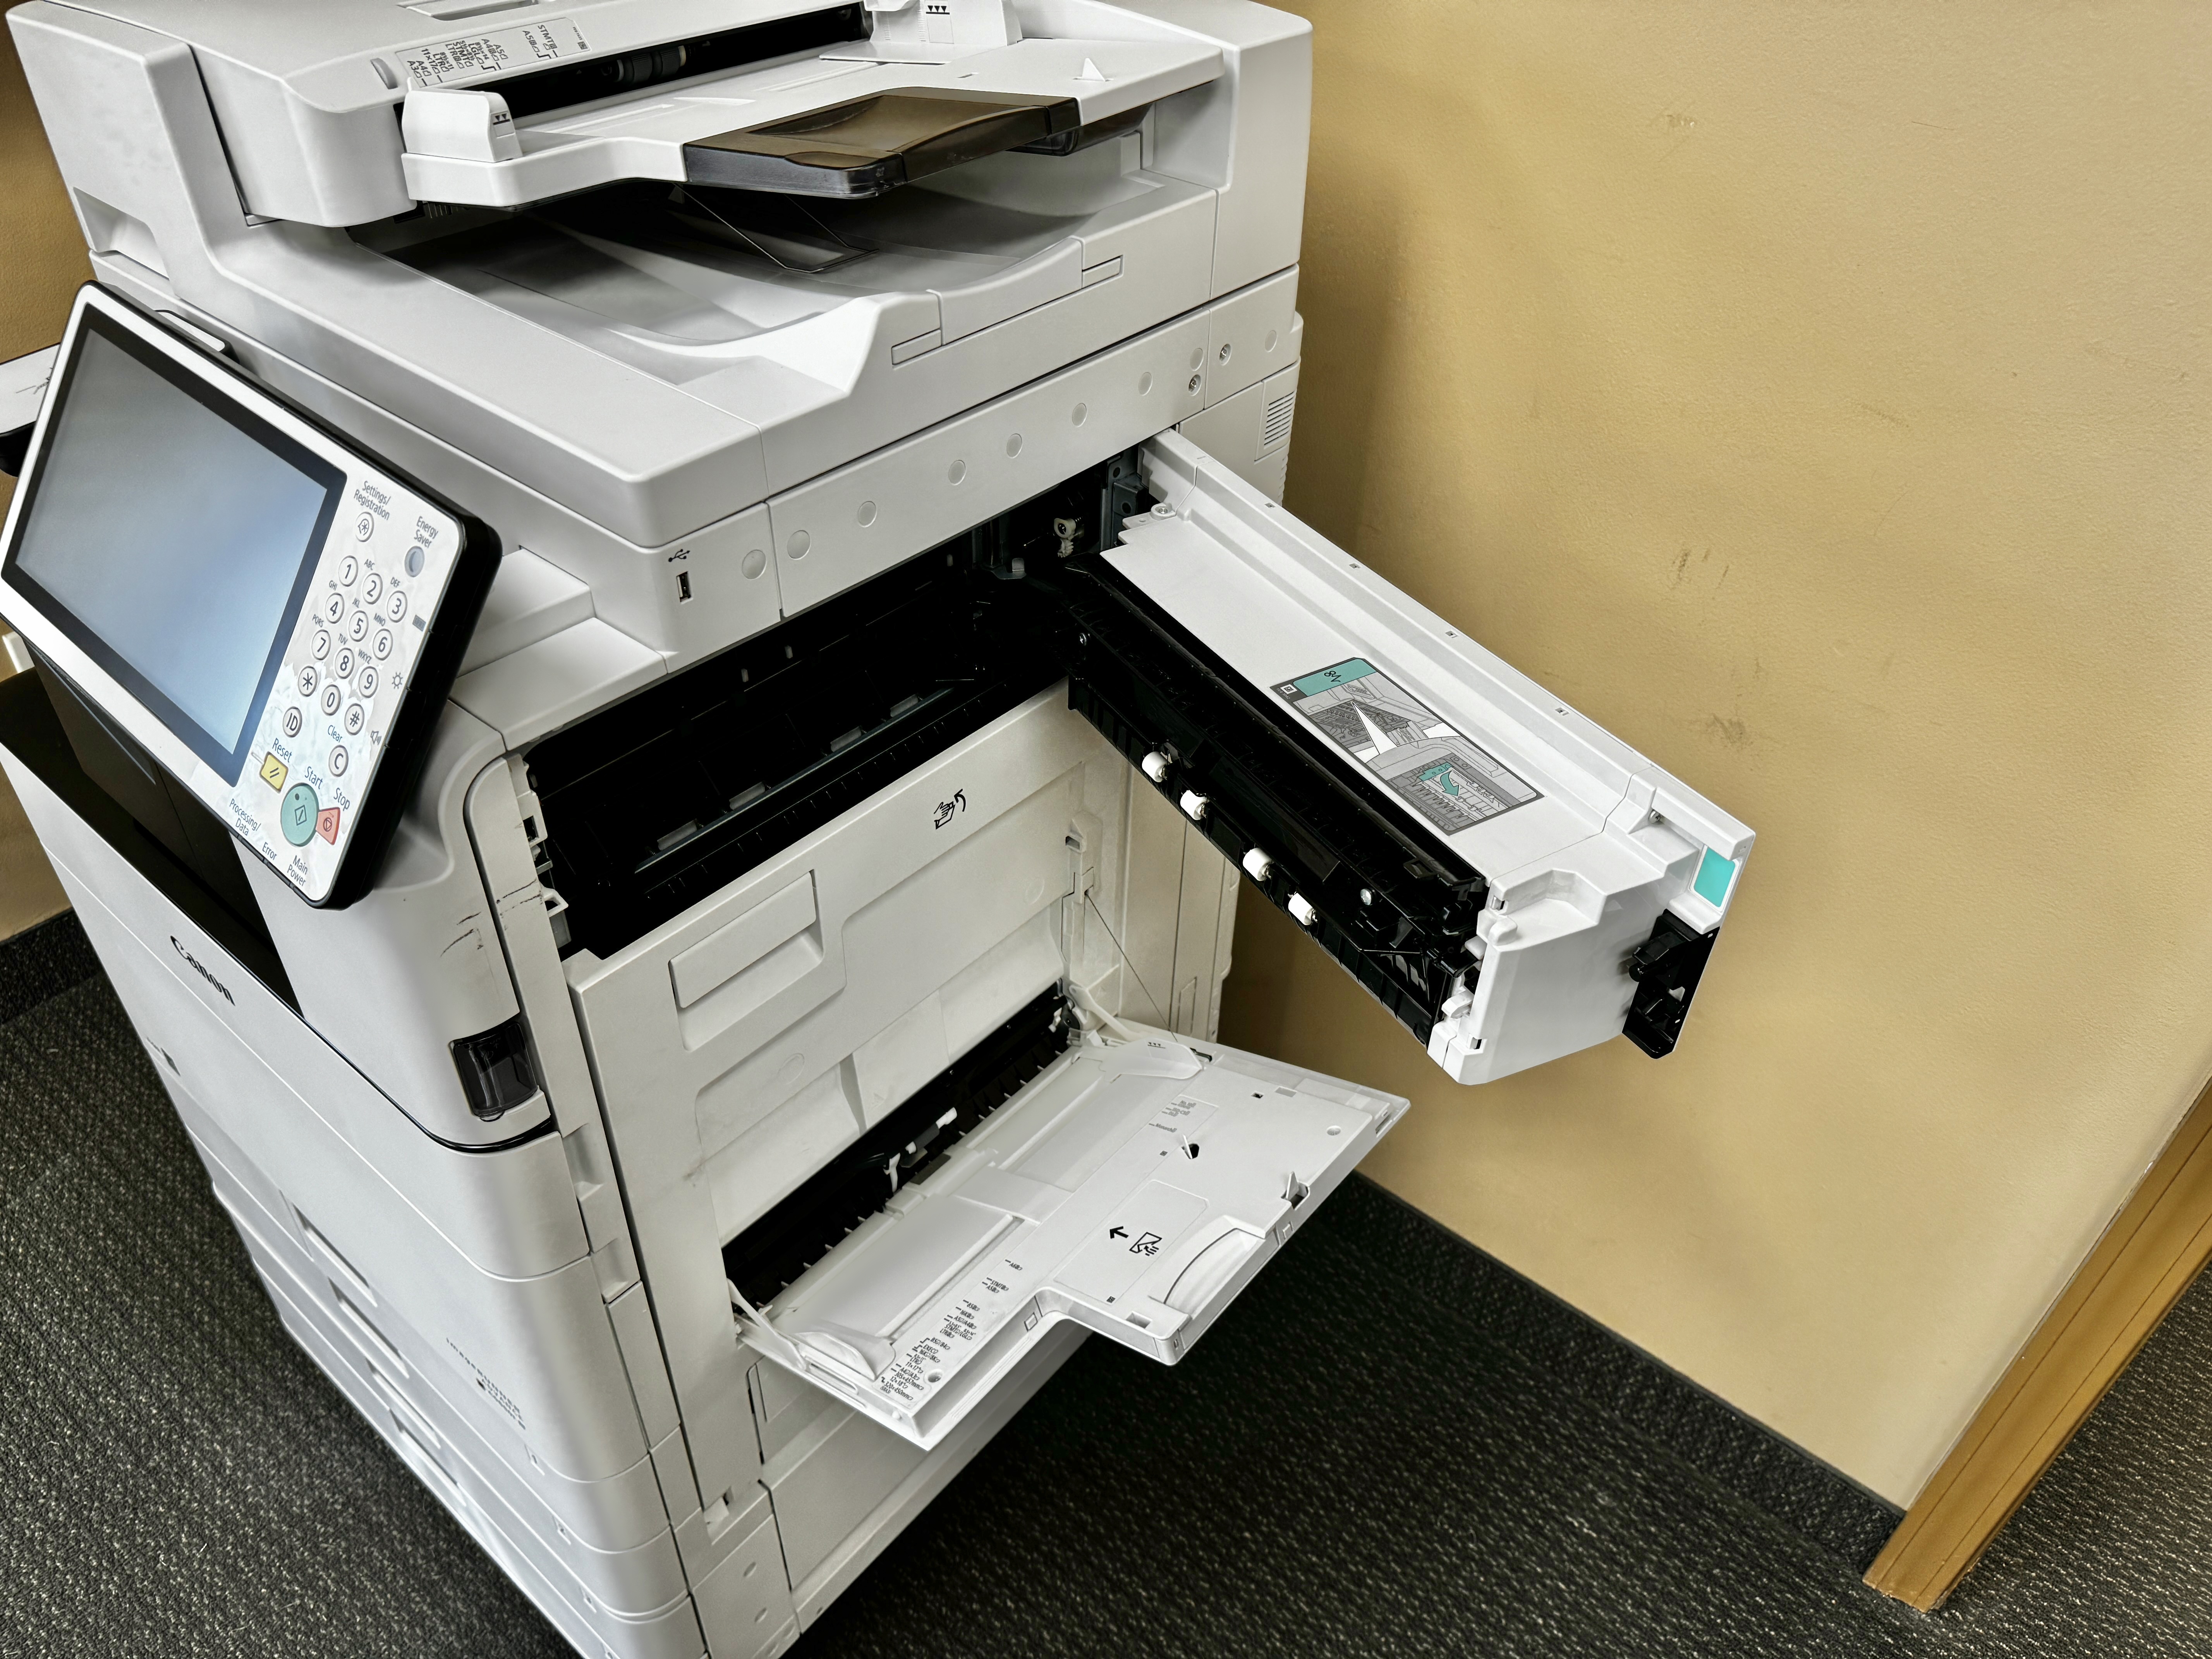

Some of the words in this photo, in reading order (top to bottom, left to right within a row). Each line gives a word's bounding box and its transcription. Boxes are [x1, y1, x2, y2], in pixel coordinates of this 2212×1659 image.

[453, 41, 470, 60] STMT
[468, 43, 480, 57] LGL
[493, 44, 505, 54] A5
[407, 60, 419, 70] A3
[416, 60, 428, 70] A4
[433, 53, 446, 67] LTR
[362, 481, 391, 505] Settings/
[354, 489, 390, 520] Registration
[416, 516, 438, 539] Energy
[414, 529, 432, 548] Saver
[345, 564, 352, 579] 1
[364, 559, 375, 570] ABC
[329, 580, 338, 591] GHI
[367, 580, 376, 598] 2
[390, 577, 401, 588] DEF
[330, 601, 338, 616] 4
[352, 598, 361, 608] JKL
[392, 598, 402, 615] 3
[312, 614, 324, 628] PQRS
[354, 618, 363, 634] 5
[374, 613, 385, 627] MNO
[317, 637, 326, 652] 7
[338, 633, 348, 645] TUV
[378, 637, 388, 652] 6
[340, 655, 349, 671] 8
[358, 649, 372, 665] WXYZ
[364, 674, 373, 690] 9
[327, 692, 335, 708] 0
[286, 713, 298, 731] ID
[350, 711, 360, 727] #
[328, 725, 343, 743] Clear
[272, 738, 292, 763] Reset
[334, 753, 343, 770] C
[305, 766, 323, 790] Start
[333, 788, 350, 811] Stop
[229, 798, 261, 831] Processing/
[235, 818, 249, 836] Data
[262, 842, 277, 860] Error
[293, 855, 308, 875] Main
[287, 864, 306, 886] Power
[170, 935, 235, 1006] Canon
